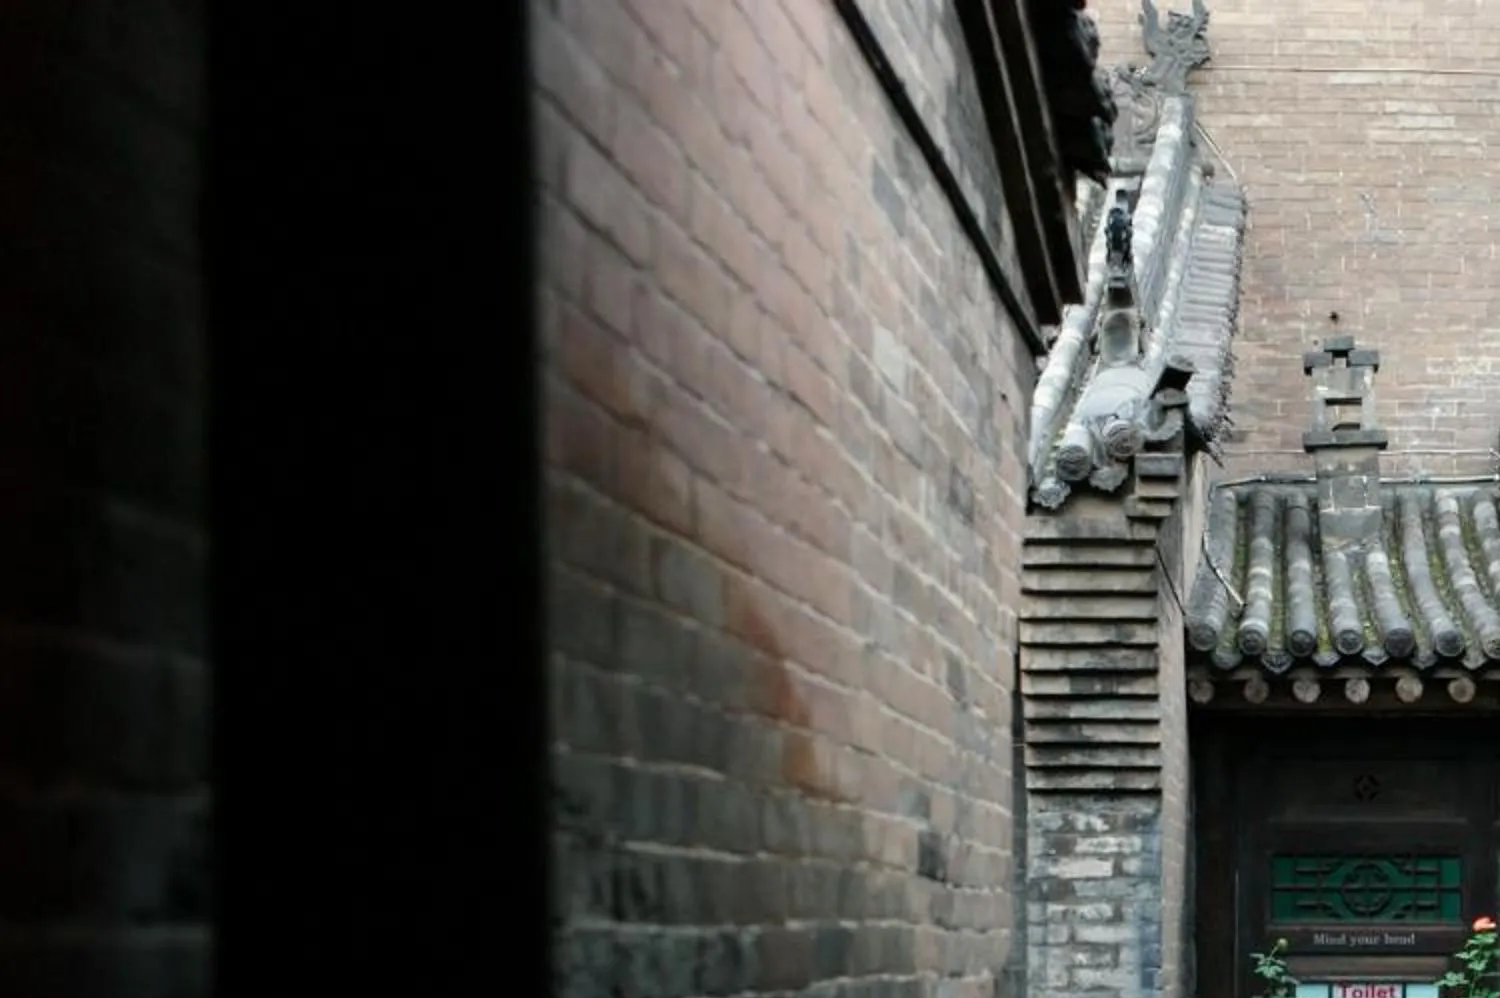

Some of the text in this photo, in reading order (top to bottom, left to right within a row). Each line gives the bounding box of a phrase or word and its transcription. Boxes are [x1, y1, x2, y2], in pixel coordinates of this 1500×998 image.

[1313, 933, 1346, 945] Mind
[1350, 936, 1379, 947] your
[1339, 983, 1397, 998] Toilet
